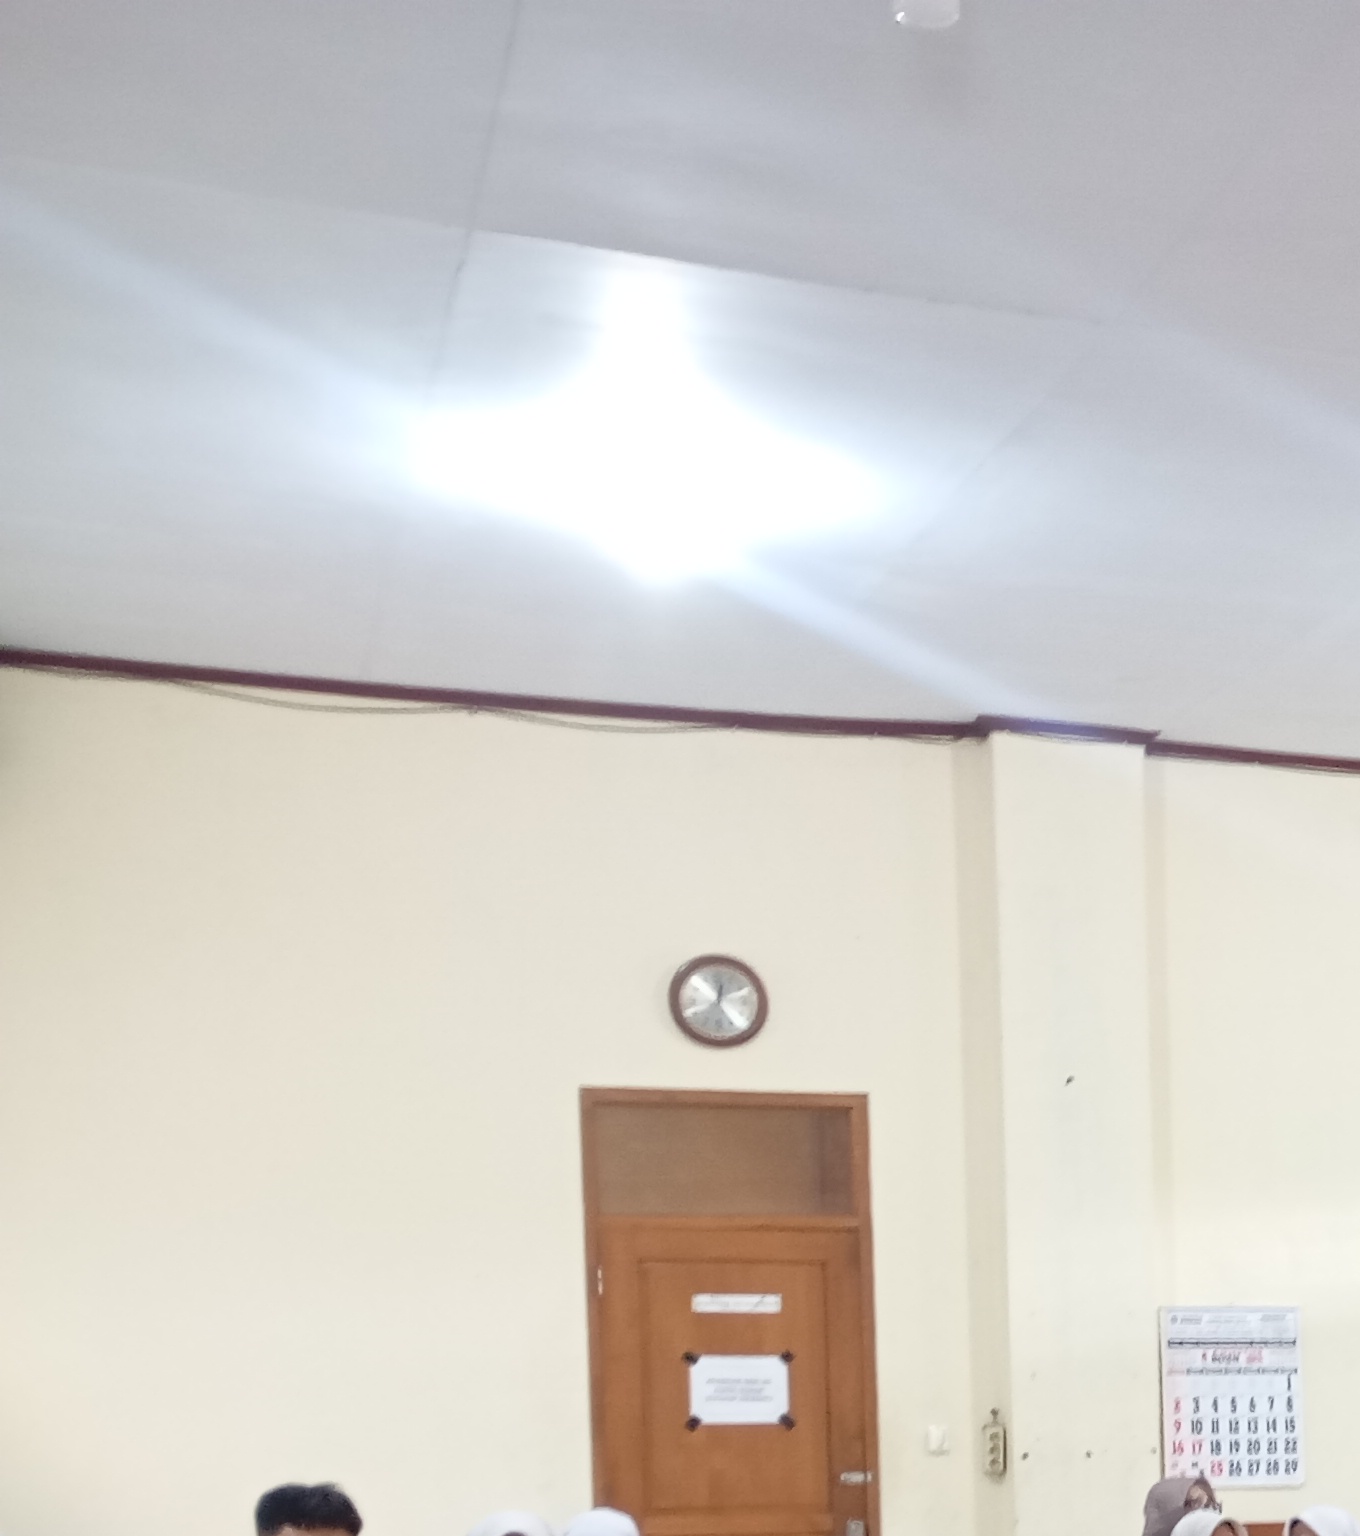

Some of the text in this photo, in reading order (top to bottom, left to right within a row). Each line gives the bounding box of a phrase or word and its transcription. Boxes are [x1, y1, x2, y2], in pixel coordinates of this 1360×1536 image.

[1192, 1396, 1200, 1414] 3
[1211, 1396, 1218, 1413] 4
[1231, 1396, 1237, 1413] 5
[1250, 1396, 1256, 1412] 6
[1268, 1396, 1274, 1411] 7
[1174, 1418, 1181, 1434] 9
[1191, 1417, 1202, 1435] 10
[1211, 1418, 1219, 1434] 11
[1248, 1416, 1258, 1434] 13
[1266, 1416, 1277, 1434] 14
[1285, 1416, 1295, 1433] 15
[1172, 1440, 1184, 1456] 16
[1192, 1439, 1202, 1456] 17
[1210, 1439, 1222, 1456] 18
[1229, 1439, 1240, 1455] 19
[1247, 1438, 1260, 1455] 20
[1267, 1438, 1277, 1454] 21
[1229, 1460, 1242, 1476] 26
[1248, 1459, 1260, 1476] 27
